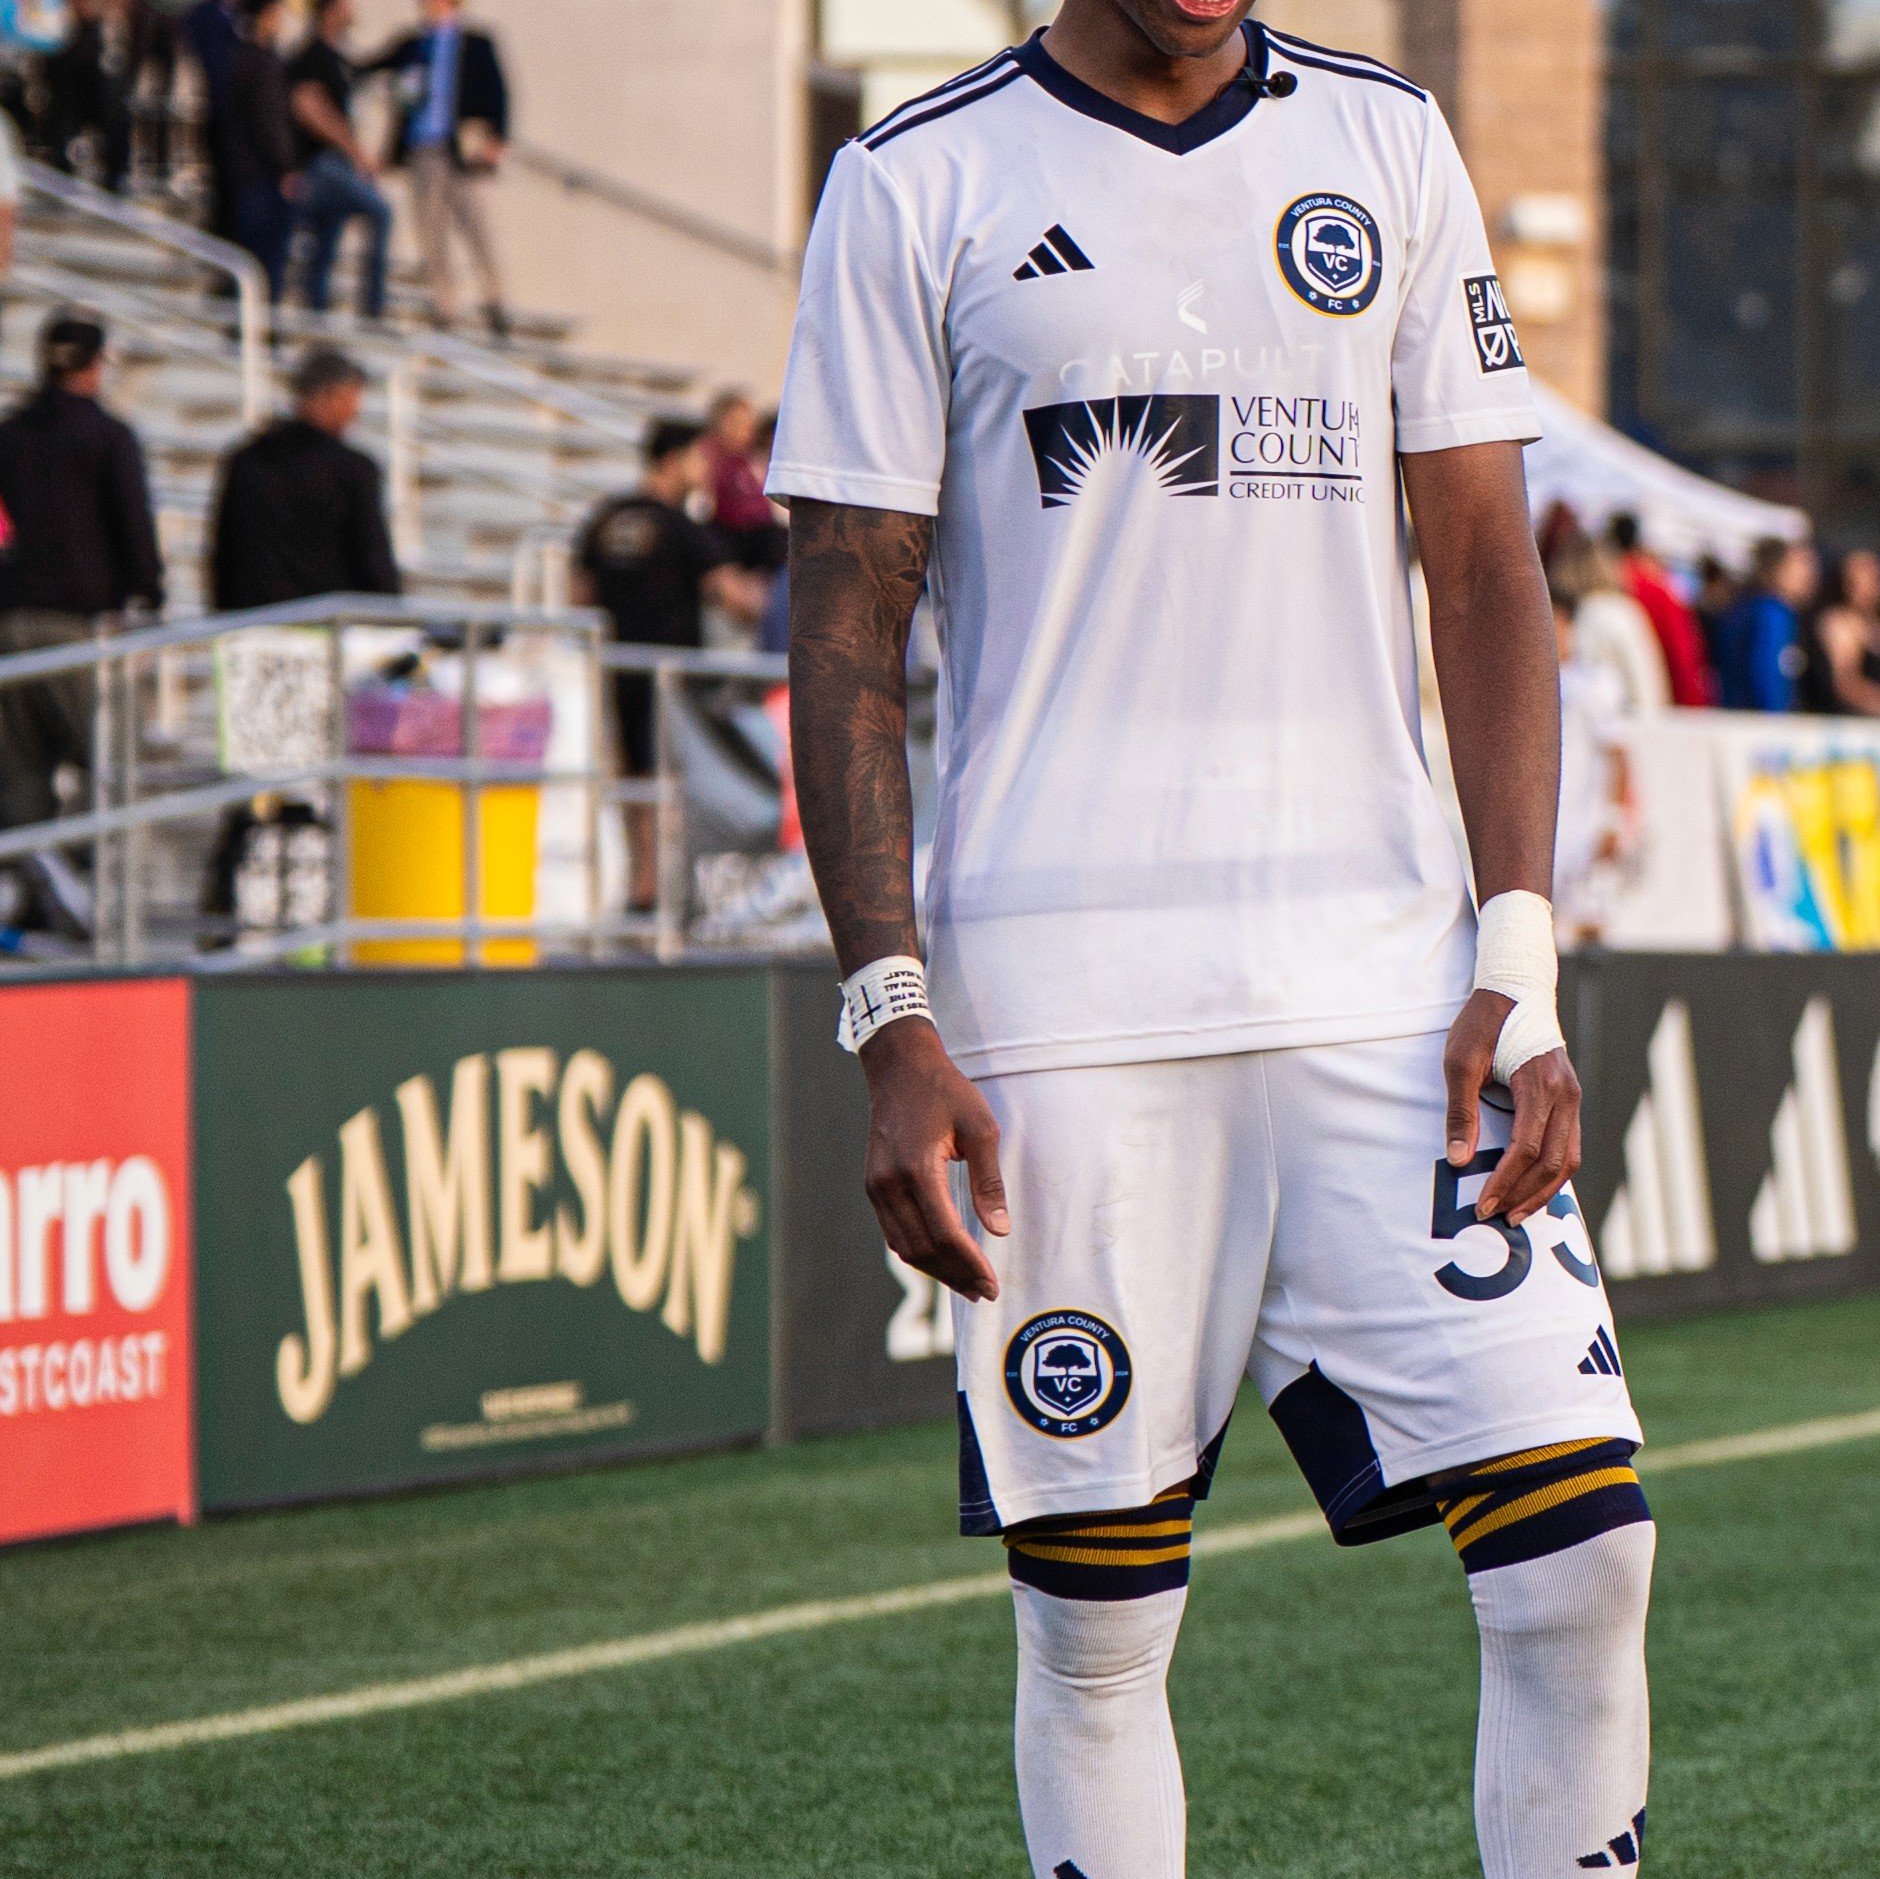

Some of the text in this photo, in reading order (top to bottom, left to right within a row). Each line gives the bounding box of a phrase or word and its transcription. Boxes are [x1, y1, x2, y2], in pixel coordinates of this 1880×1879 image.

[1290, 197, 1371, 226] VENTURA COUNTY
[1322, 253, 1348, 271] VC
[1327, 299, 1343, 310] FC
[1468, 282, 1488, 323] MLS
[1229, 482, 1304, 500] CREDIT
[884, 983, 899, 992] ALL
[277, 1046, 747, 1424] JAMESON
[1020, 1316, 1110, 1341] VENTURA COUNTY
[1054, 1377, 1082, 1392] VC
[1061, 1423, 1077, 1432] FC
